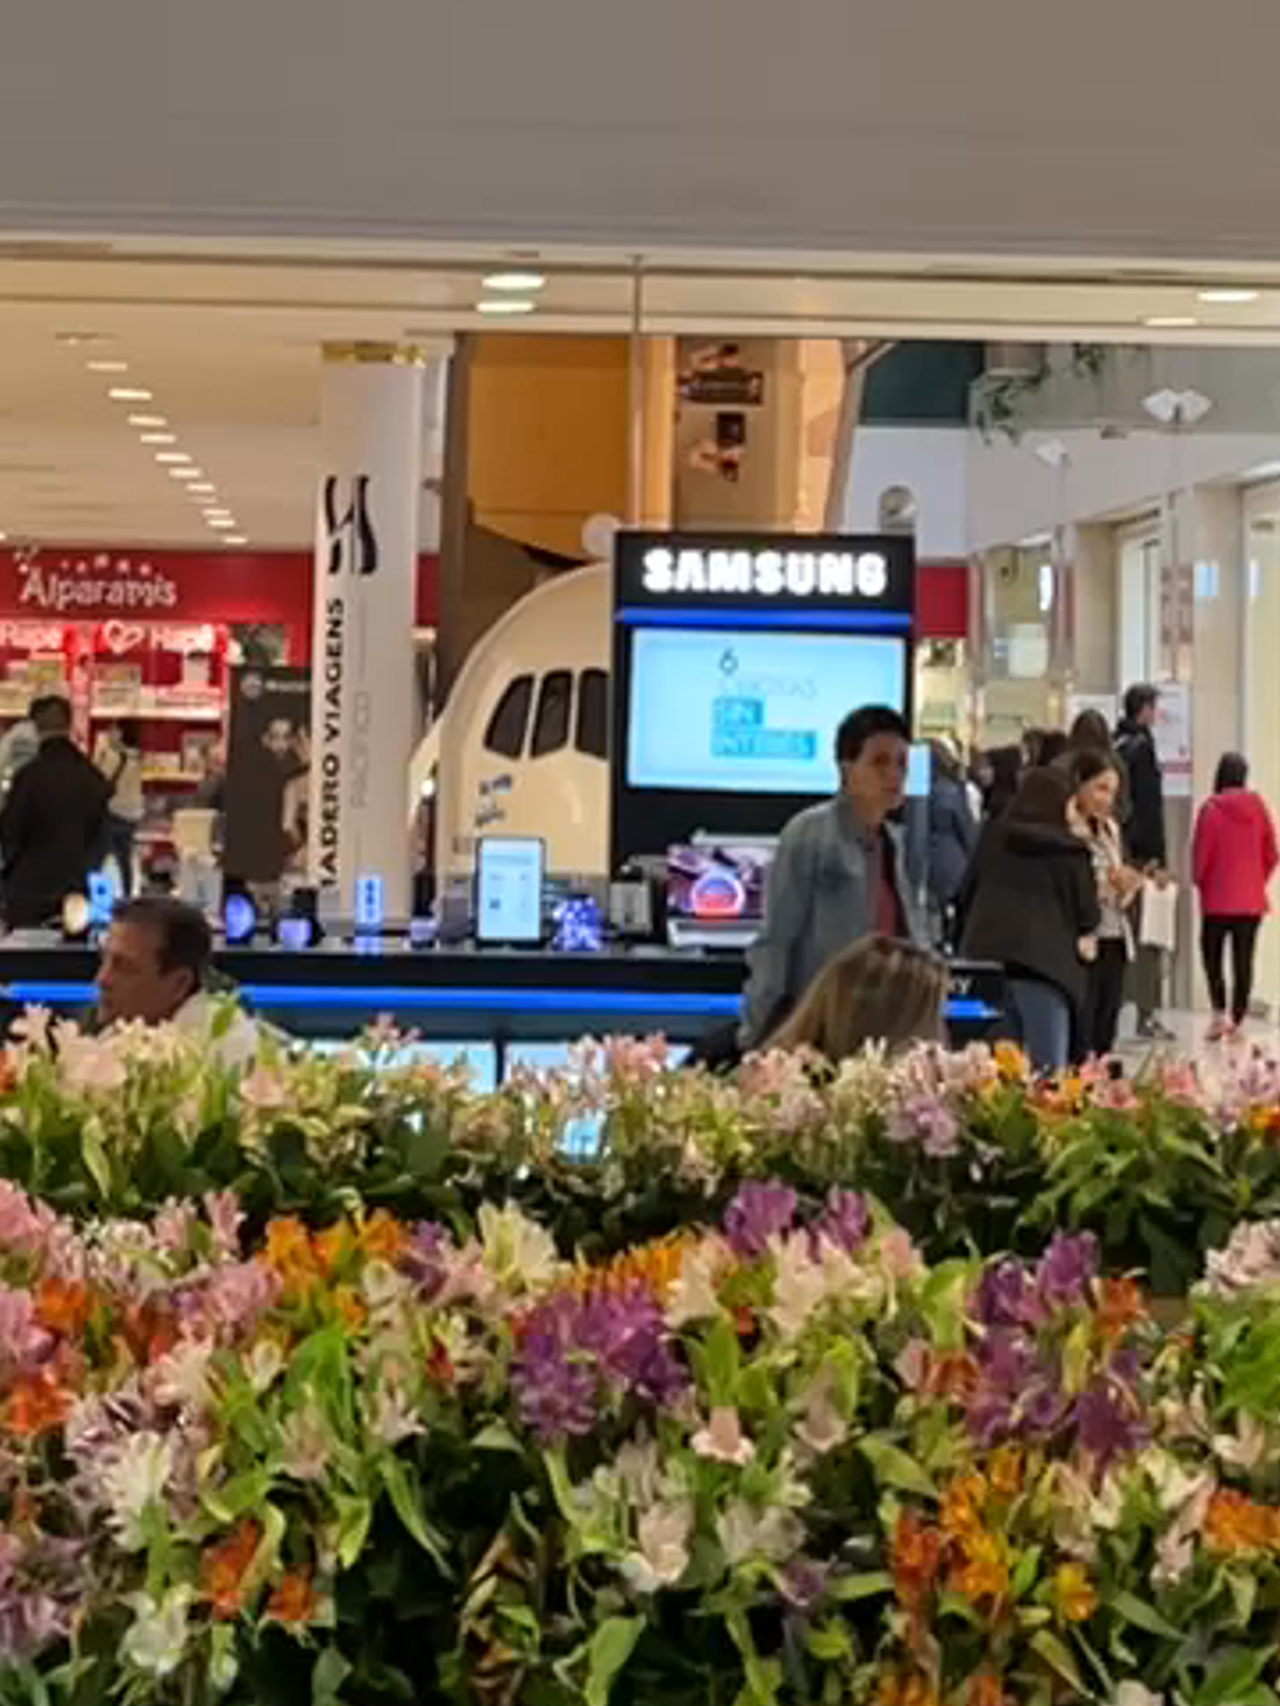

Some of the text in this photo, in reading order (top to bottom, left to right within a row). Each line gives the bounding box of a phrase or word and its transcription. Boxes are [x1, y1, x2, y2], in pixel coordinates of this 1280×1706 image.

[19, 566, 179, 610] Alparamis
[642, 546, 887, 597] SAMSUNG
[323, 597, 345, 743] VIAGENS
[718, 646, 739, 676] 6
